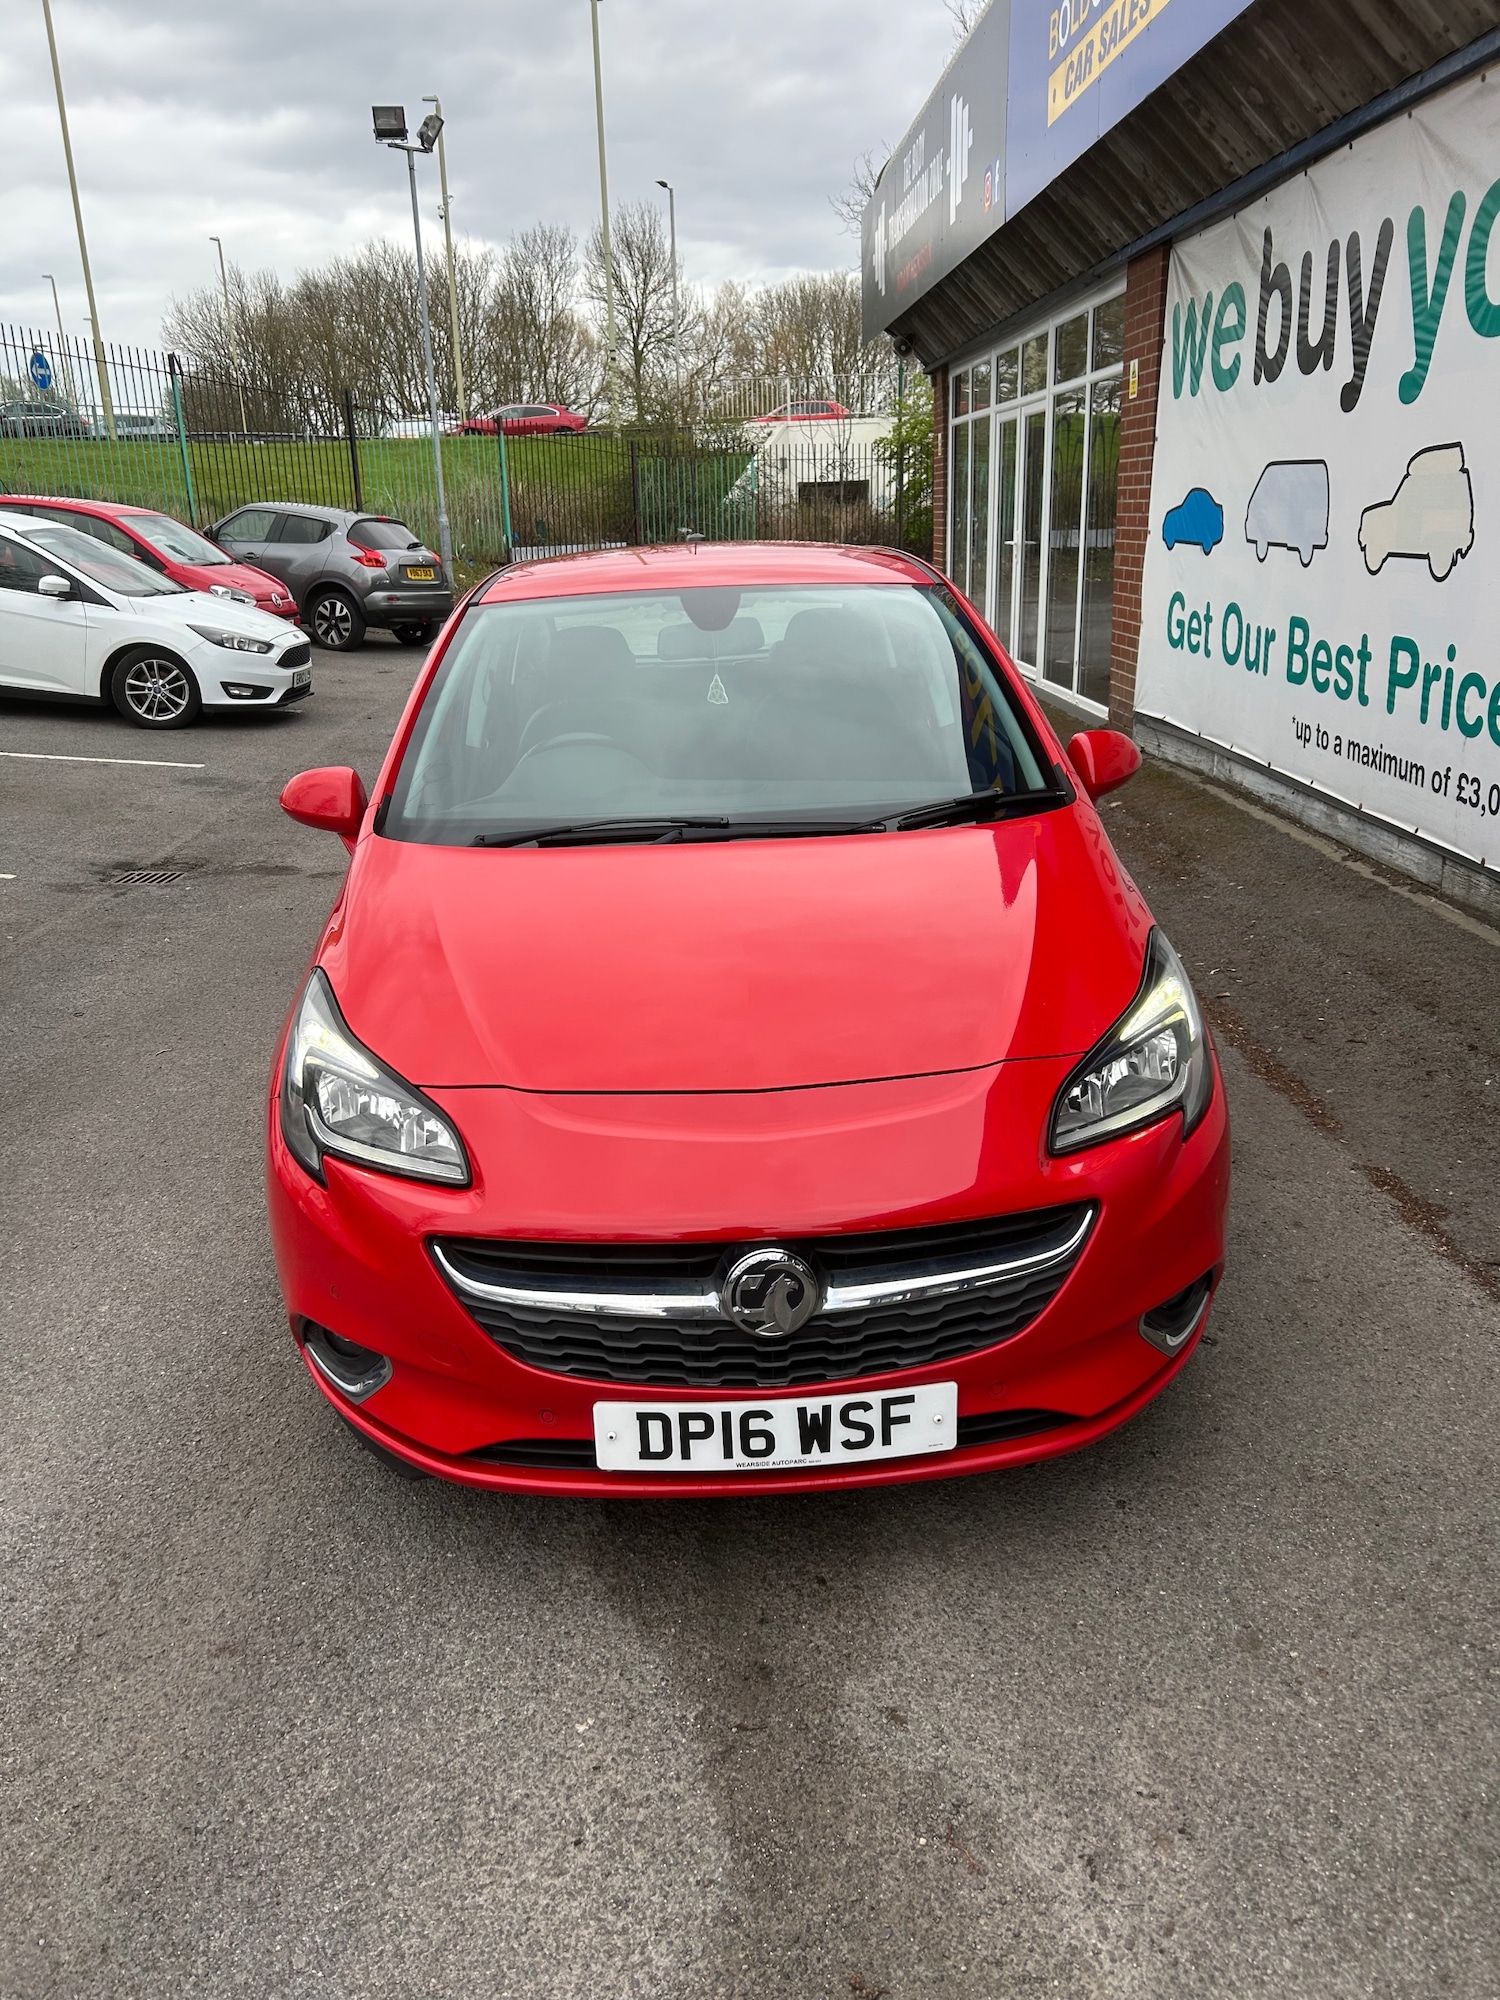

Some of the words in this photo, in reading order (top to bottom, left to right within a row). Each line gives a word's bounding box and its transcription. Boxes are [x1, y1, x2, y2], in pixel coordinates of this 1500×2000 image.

[1048, 0, 1100, 61] BOL
[1065, 39, 1095, 100] CAR
[1167, 591, 1213, 659] Get
[1221, 602, 1276, 677] Our
[1286, 615, 1372, 707] Best
[1316, 723, 1330, 750] to
[1333, 734, 1342, 756] a
[1346, 742, 1425, 788] maximum
[1431, 766, 1452, 797] of
[635, 1409, 776, 1461] DP16
[796, 1394, 916, 1454] WSF
[771, 1458, 807, 1467] AUTOPARC
